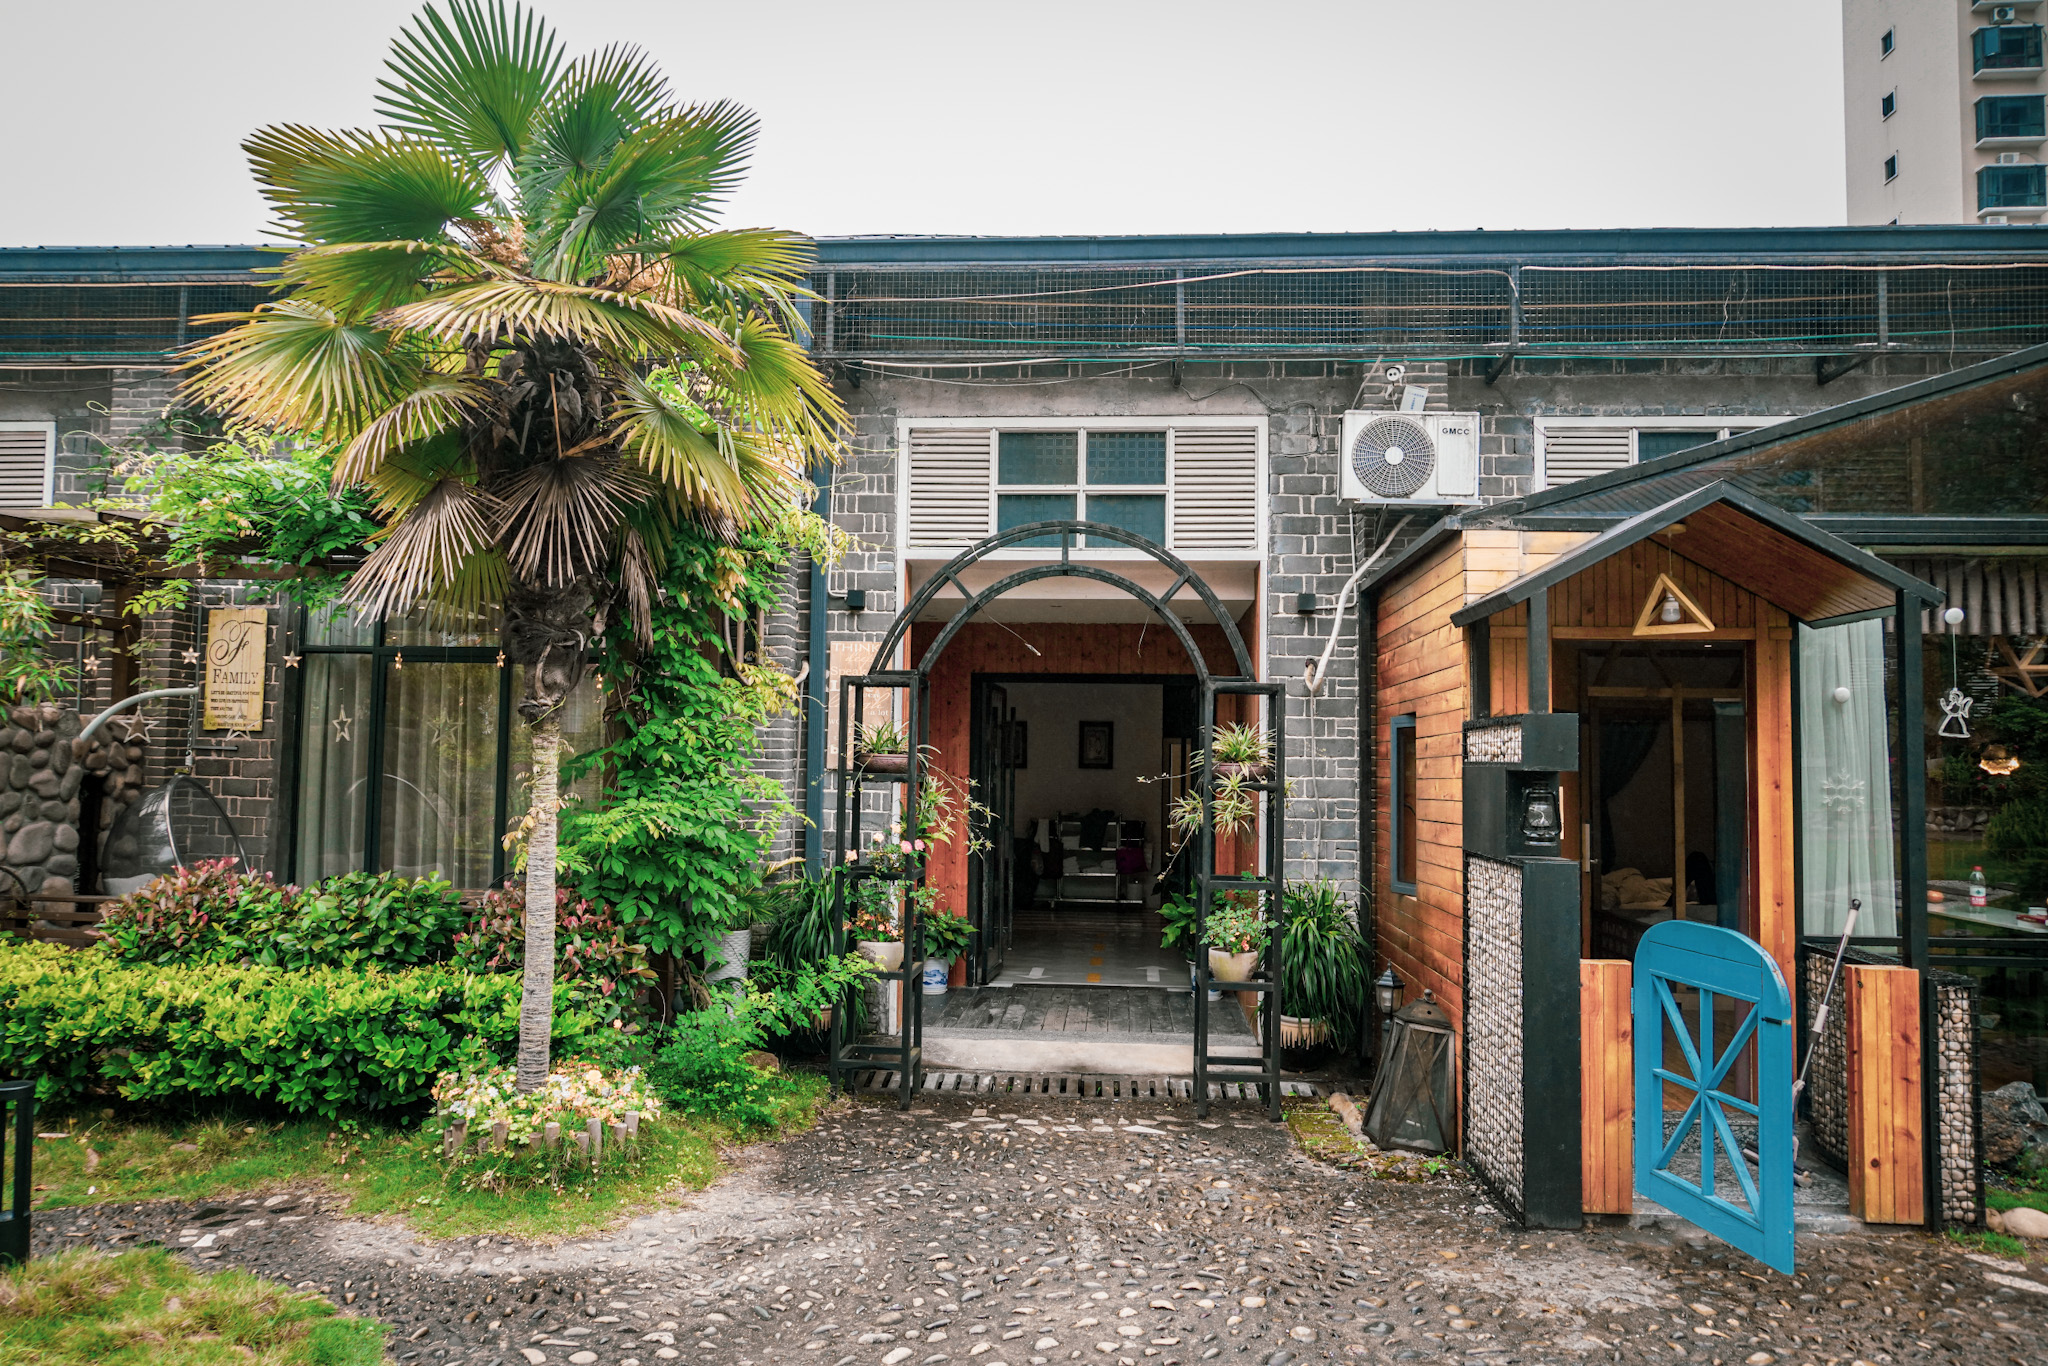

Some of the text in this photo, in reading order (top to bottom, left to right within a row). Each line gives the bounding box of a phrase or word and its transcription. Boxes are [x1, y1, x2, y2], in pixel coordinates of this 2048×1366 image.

[1442, 427, 1470, 436] GMCC
[831, 642, 880, 653] THINK
[212, 668, 259, 685] FAMILY
